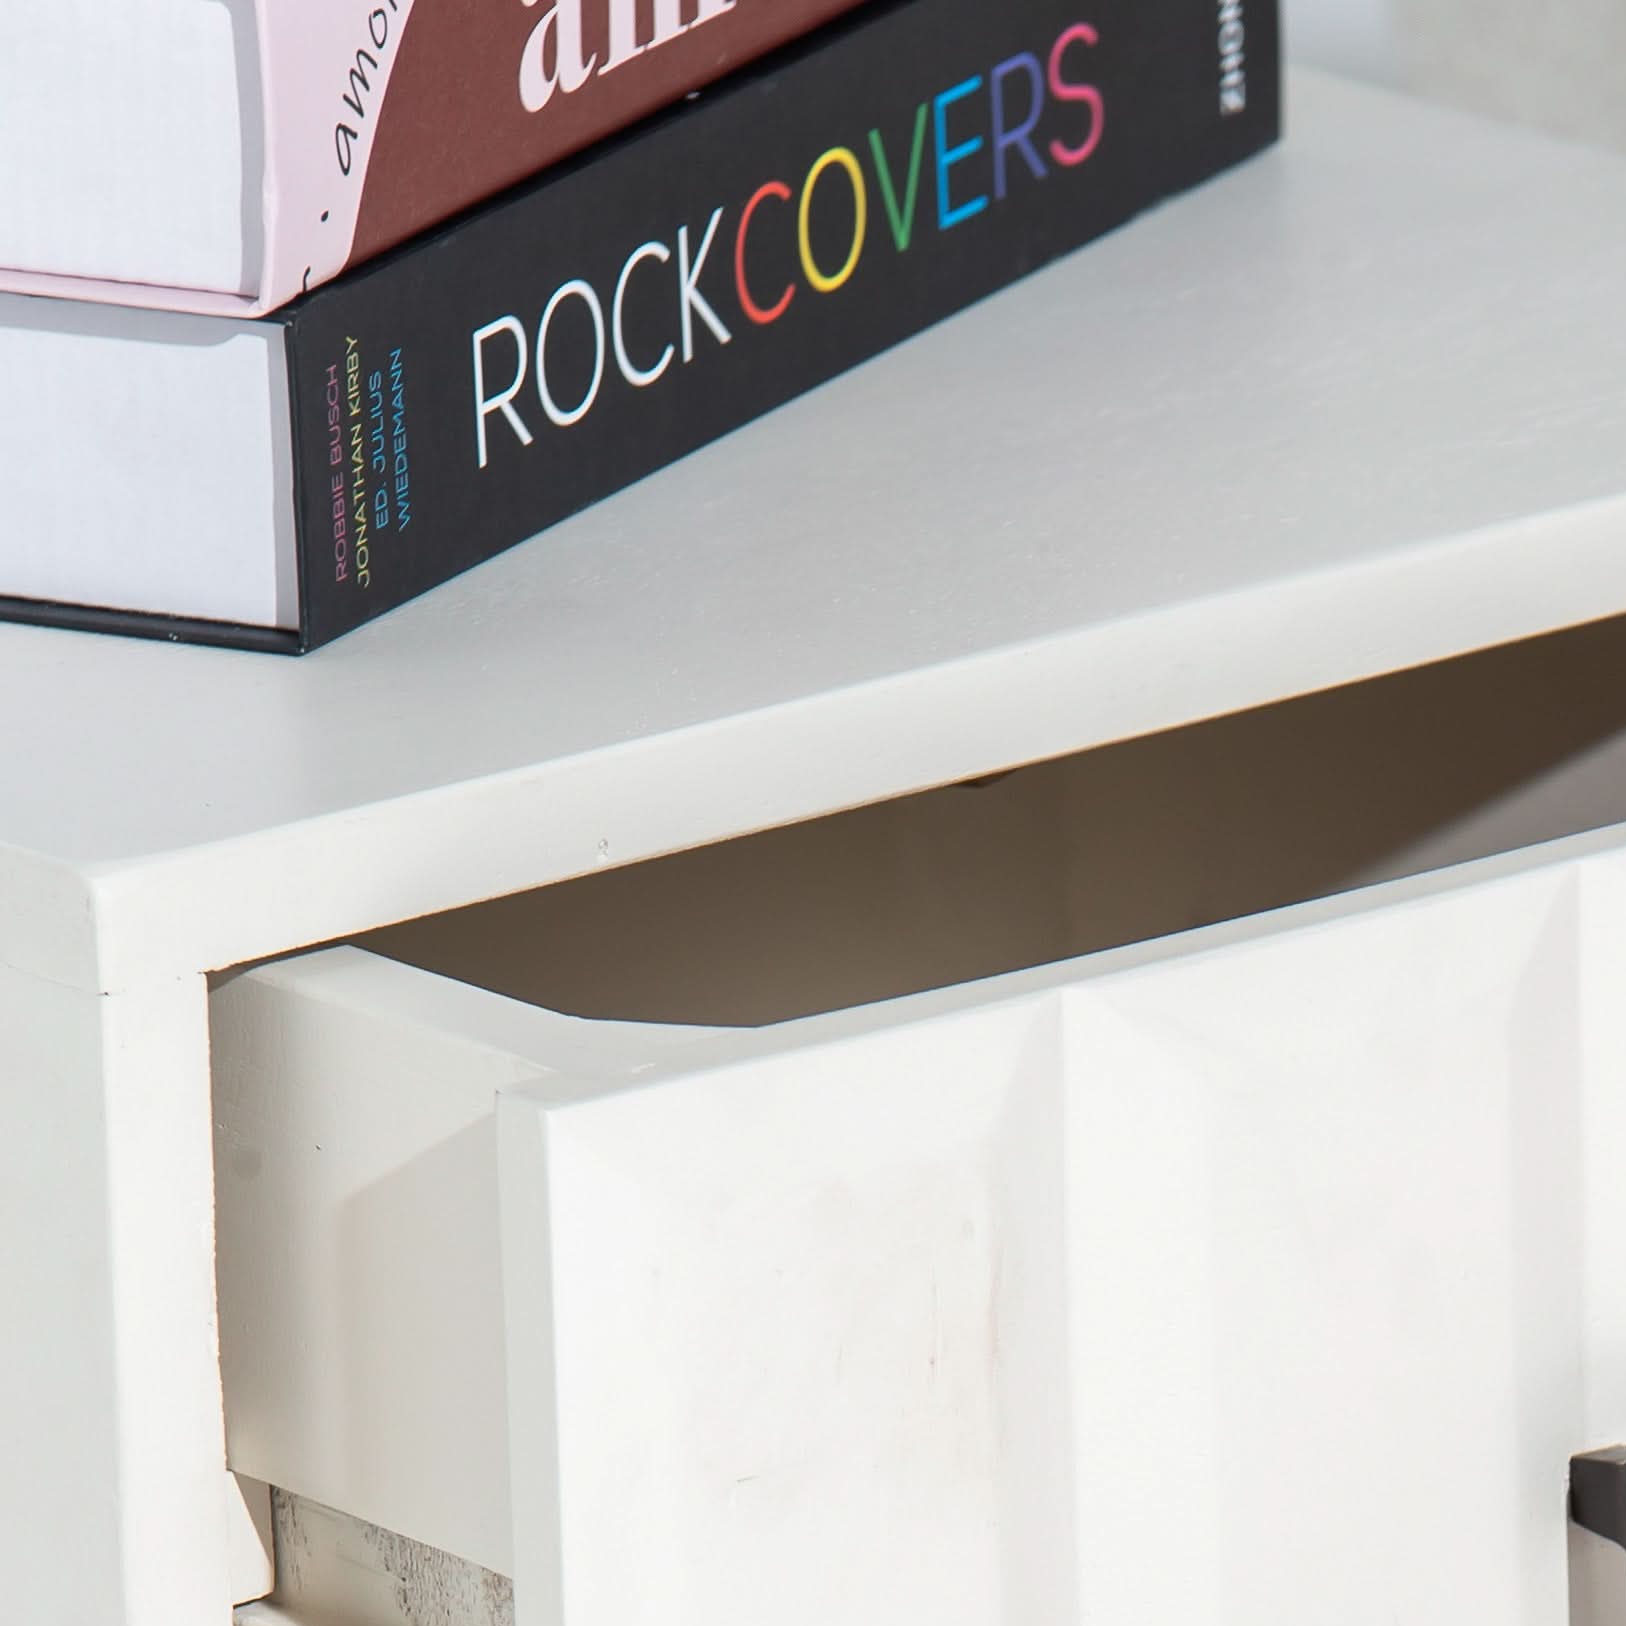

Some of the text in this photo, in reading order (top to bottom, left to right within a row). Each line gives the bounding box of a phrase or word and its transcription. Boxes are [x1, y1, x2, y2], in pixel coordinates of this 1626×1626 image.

[325, 364, 347, 582] ROBBIE BUSCH
[345, 336, 371, 589] JONATHAN KIRBY
[369, 370, 389, 530] ED. JULIUS
[390, 347, 412, 533] WIEDEMANN
